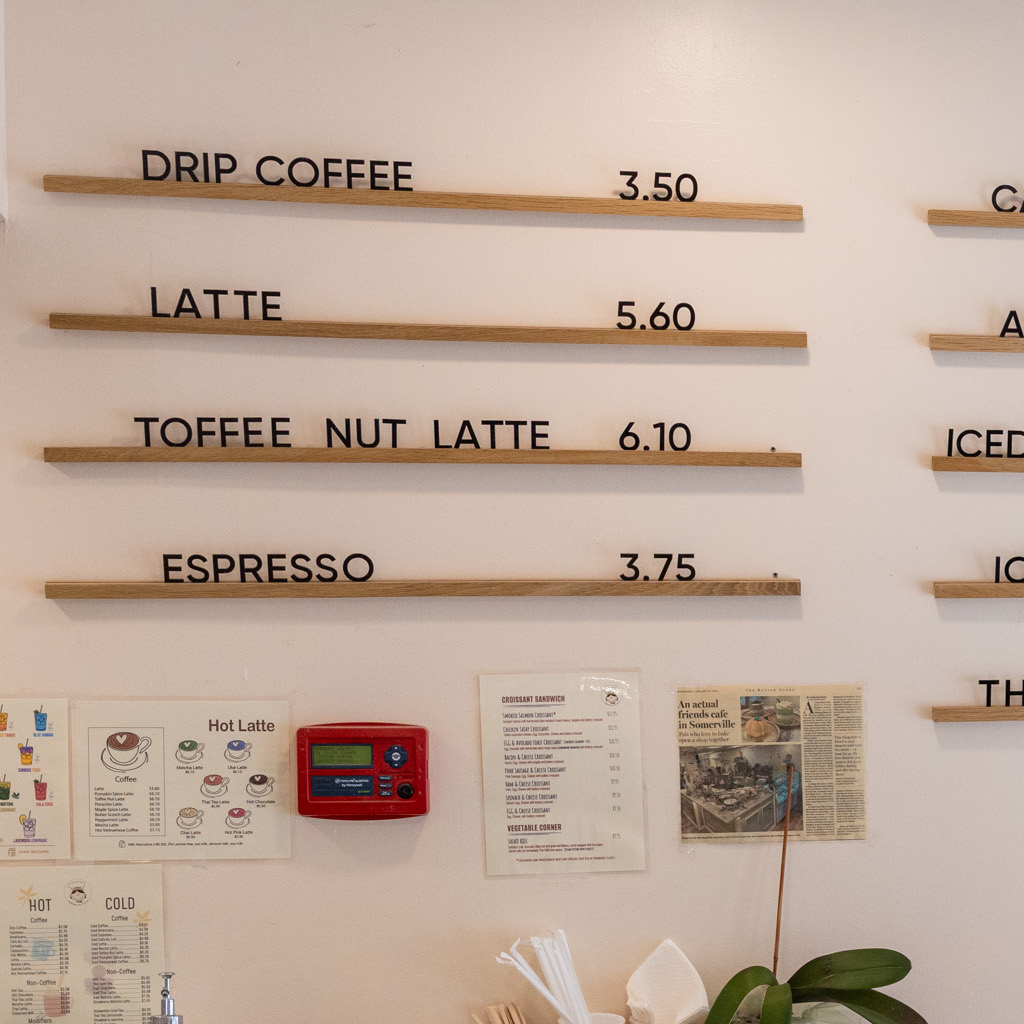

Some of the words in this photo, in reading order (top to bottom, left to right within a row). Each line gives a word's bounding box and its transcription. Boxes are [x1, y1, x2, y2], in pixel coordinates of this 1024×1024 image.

[142, 150, 237, 184] DRIP
[256, 156, 413, 191] COFFEE
[619, 171, 697, 202] 3.50
[151, 287, 282, 320] LATTE
[617, 302, 695, 331] 5.60
[134, 417, 291, 448] TOFFEE
[326, 418, 406, 448] NUT
[434, 420, 550, 449] LATTE
[619, 422, 691, 451] 6.10
[162, 554, 373, 583] ESPRESSO
[620, 554, 695, 581] 3.75
[502, 696, 533, 704] CROISSANT
[678, 700, 690, 708] An
[692, 699, 718, 708] actual
[678, 710, 709, 719] friends
[711, 709, 728, 718] cafe
[208, 719, 234, 732] Hot
[238, 719, 275, 732] Latte
[678, 720, 687, 729] in
[689, 720, 736, 729] Somerville
[507, 824, 538, 832] VEGETABLE
[539, 823, 562, 831] CORNER
[29, 898, 52, 912] HOT
[105, 897, 135, 910] COLD
